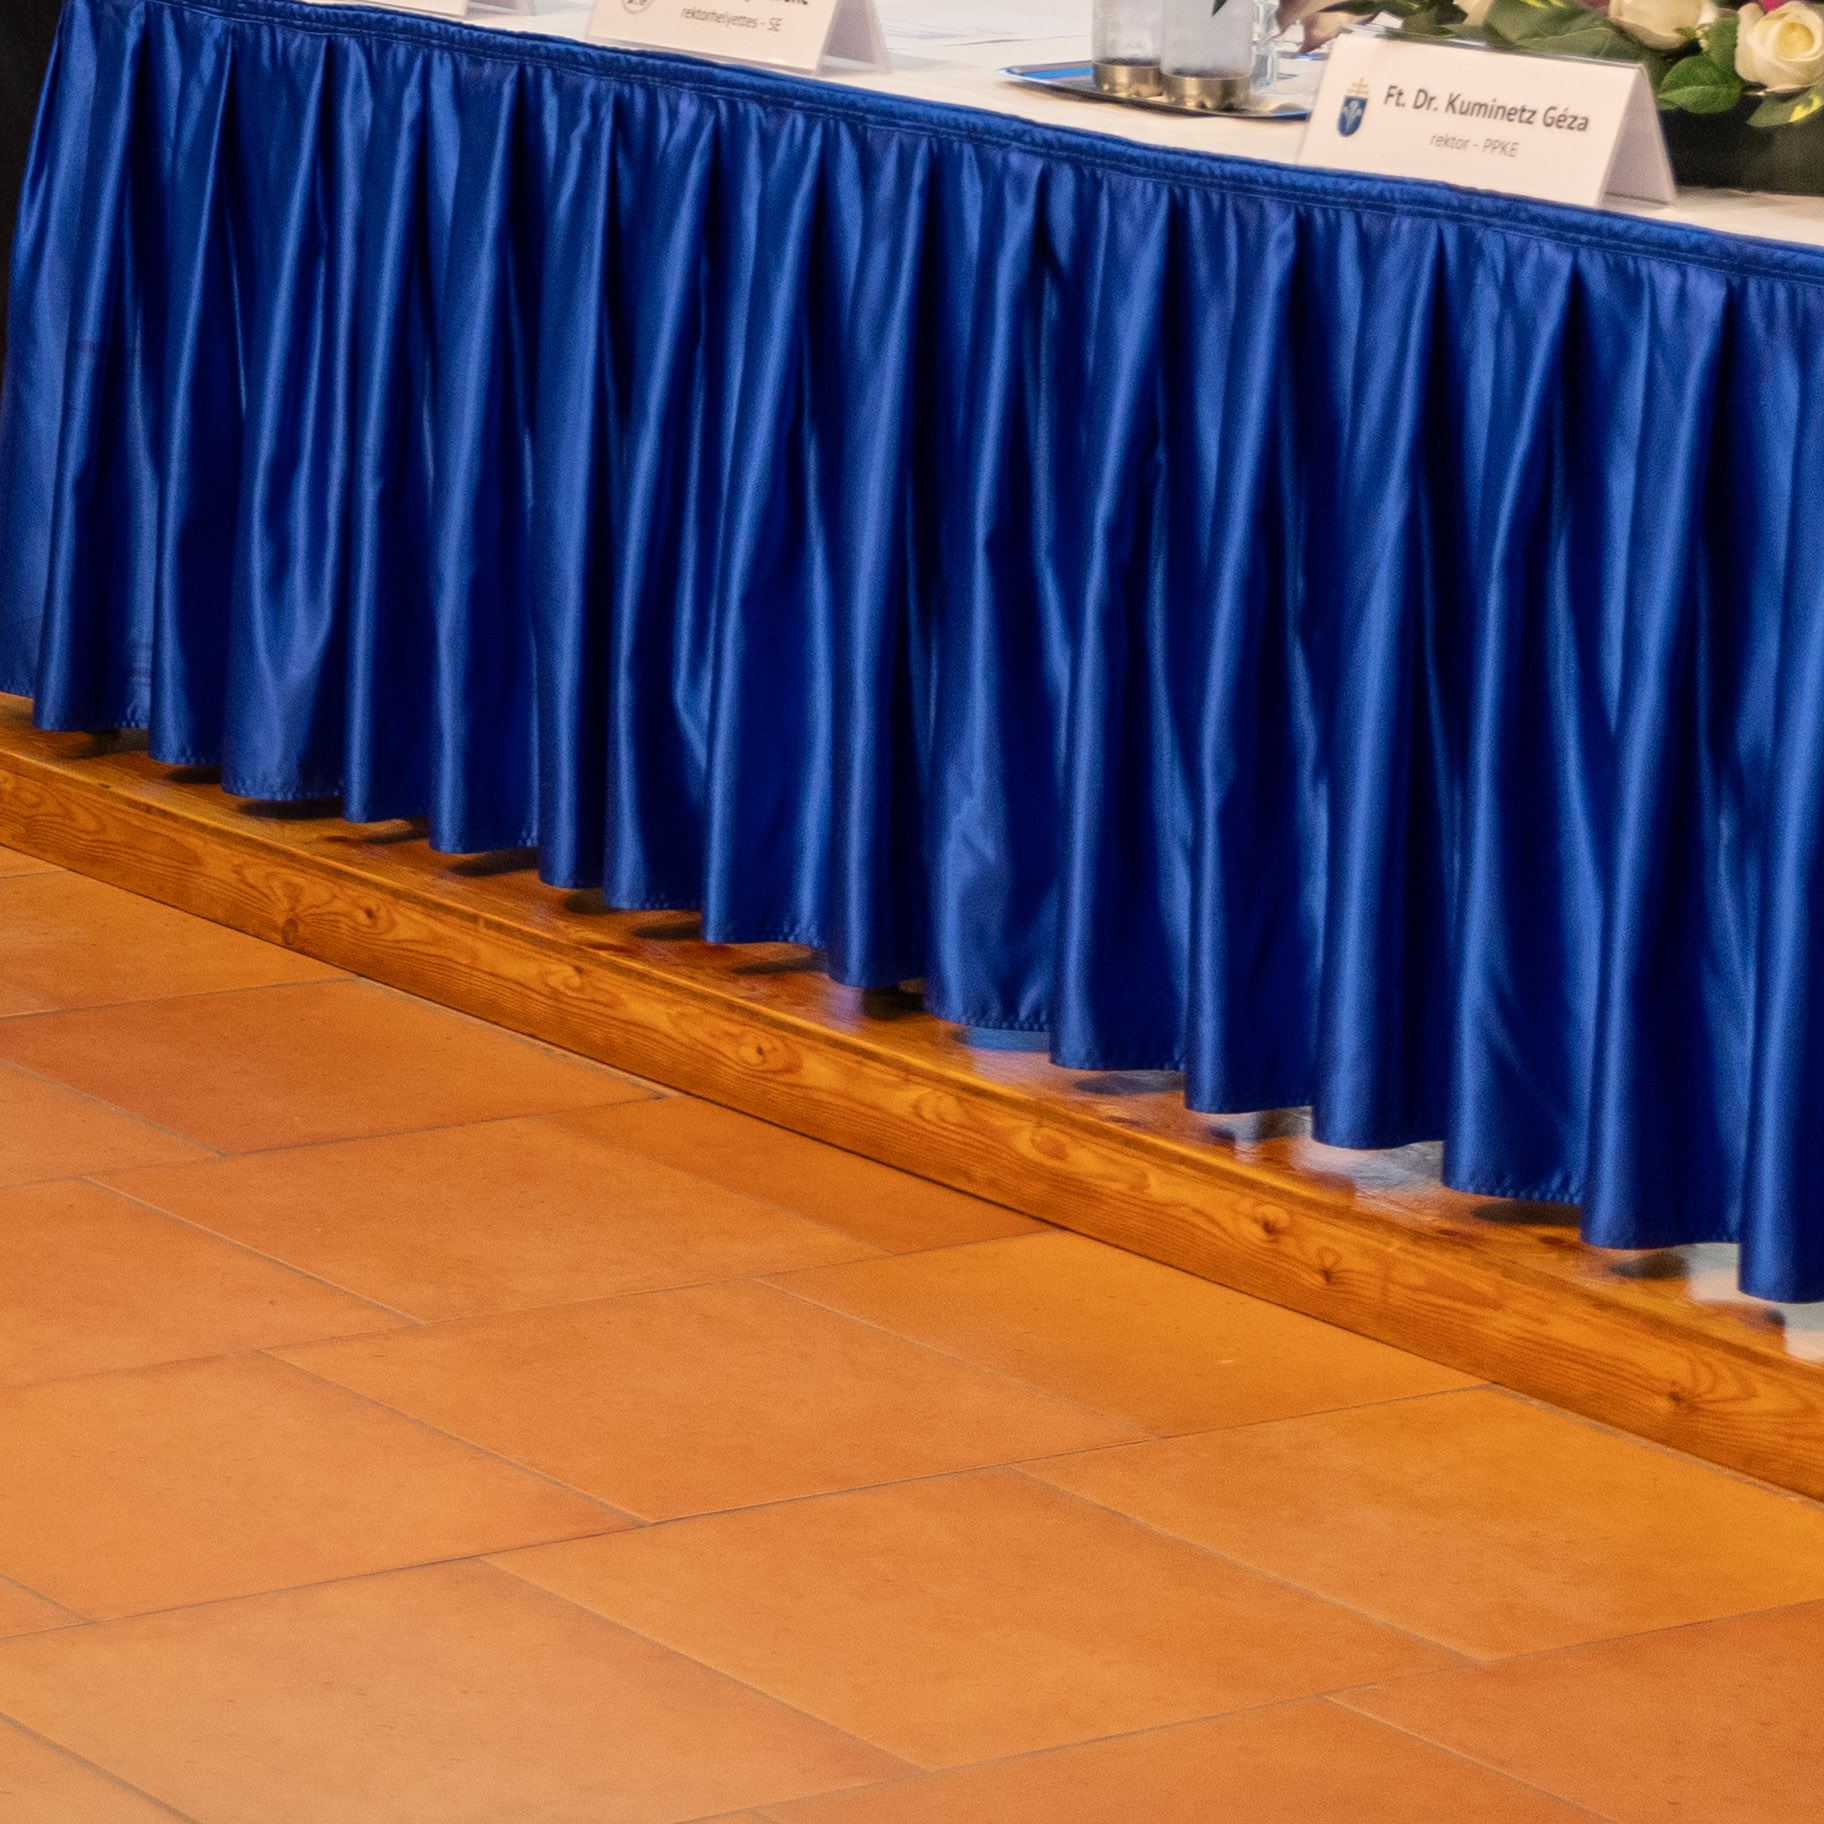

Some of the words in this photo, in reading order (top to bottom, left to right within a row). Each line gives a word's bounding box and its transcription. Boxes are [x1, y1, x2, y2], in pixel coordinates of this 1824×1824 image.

[767, 17, 783, 32] SE
[1384, 85, 1406, 108] Ft.
[1413, 89, 1438, 112] Dr.
[1445, 93, 1537, 125] Kuminetz
[1543, 105, 1589, 132] Géza
[1430, 133, 1470, 151] rektor
[1482, 139, 1520, 158] PPKE
